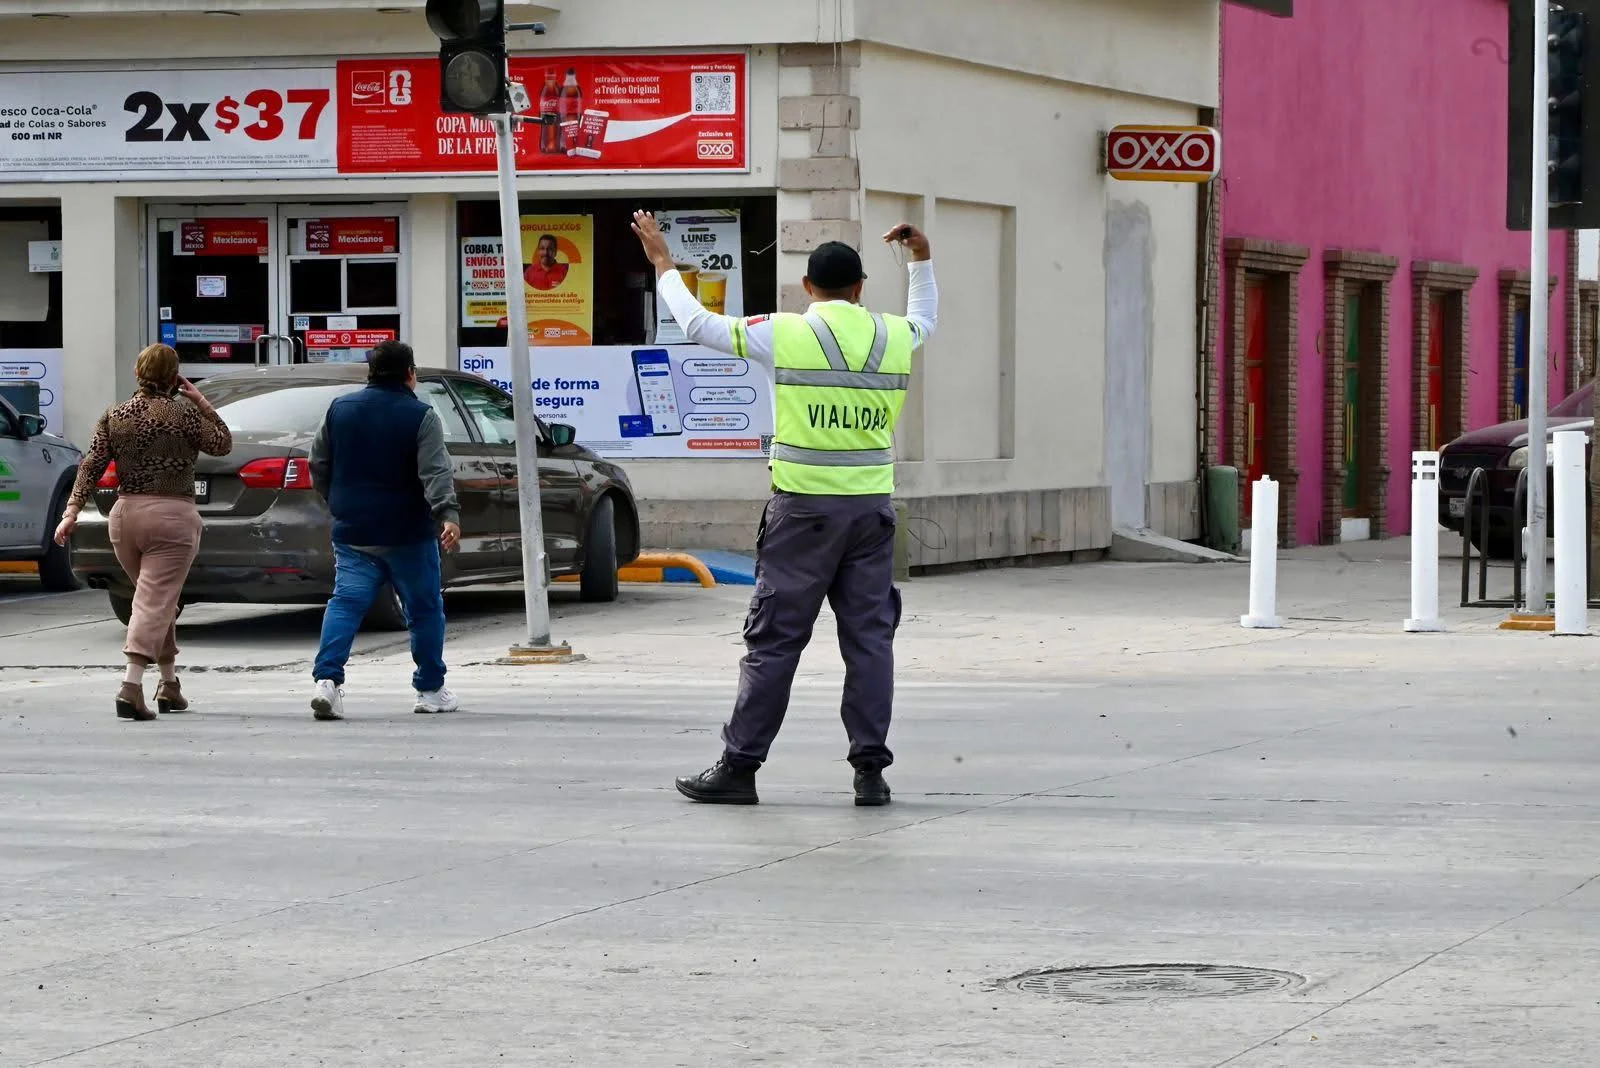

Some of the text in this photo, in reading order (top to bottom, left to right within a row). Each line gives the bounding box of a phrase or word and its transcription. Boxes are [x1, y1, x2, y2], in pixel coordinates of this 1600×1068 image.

[601, 85, 627, 94] Trofeo
[628, 85, 660, 96] Original
[14, 119, 25, 128] de
[28, 119, 56, 128] Colas
[67, 119, 107, 128] Sabores
[436, 116, 525, 133] COPA MUNL
[11, 131, 63, 141] 600 ml NR
[438, 137, 454, 155] DE
[457, 138, 473, 155] LA
[699, 143, 733, 156] OXXO
[1112, 133, 1210, 170] OXXO
[213, 235, 258, 244] Mexicanos
[338, 234, 384, 243] Mexicanos
[681, 233, 717, 243] LUNES
[464, 243, 494, 254] COBRA
[465, 254, 498, 267] ENVÍOS
[701, 253, 734, 271] $20
[472, 268, 506, 279] DINERO
[211, 346, 228, 354] SALIDA
[463, 355, 494, 372] spin
[531, 377, 551, 390] de
[554, 377, 600, 390] forma
[535, 396, 584, 410] segura
[807, 404, 888, 431] VIALIDAD
